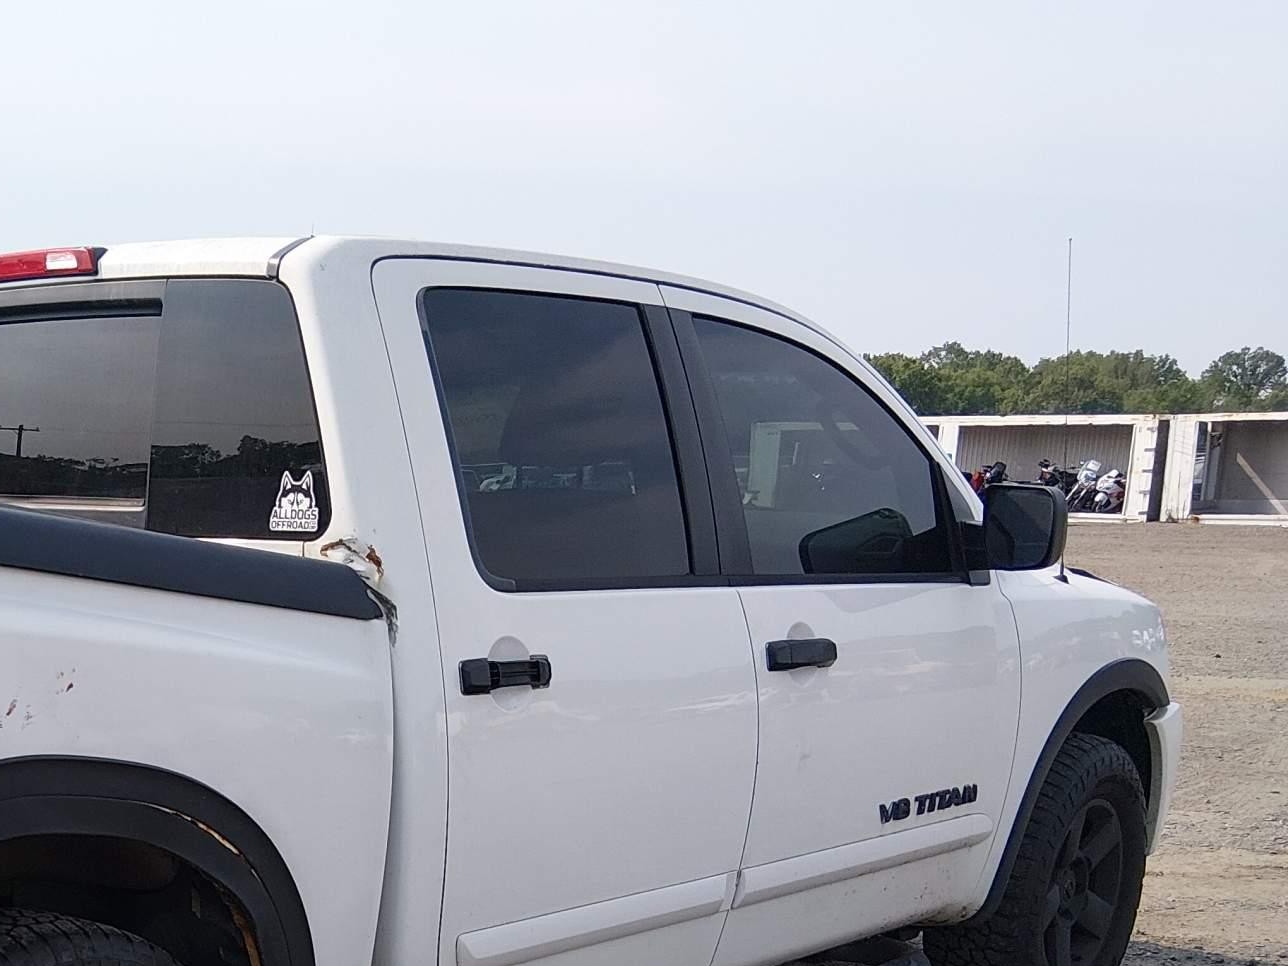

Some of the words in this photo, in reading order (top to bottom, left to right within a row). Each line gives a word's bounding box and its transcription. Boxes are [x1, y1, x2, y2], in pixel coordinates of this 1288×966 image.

[271, 509, 317, 520] ALLDOGS
[270, 520, 310, 530] OFFROAD
[878, 797, 911, 824] V8
[914, 783, 978, 816] TITAN
